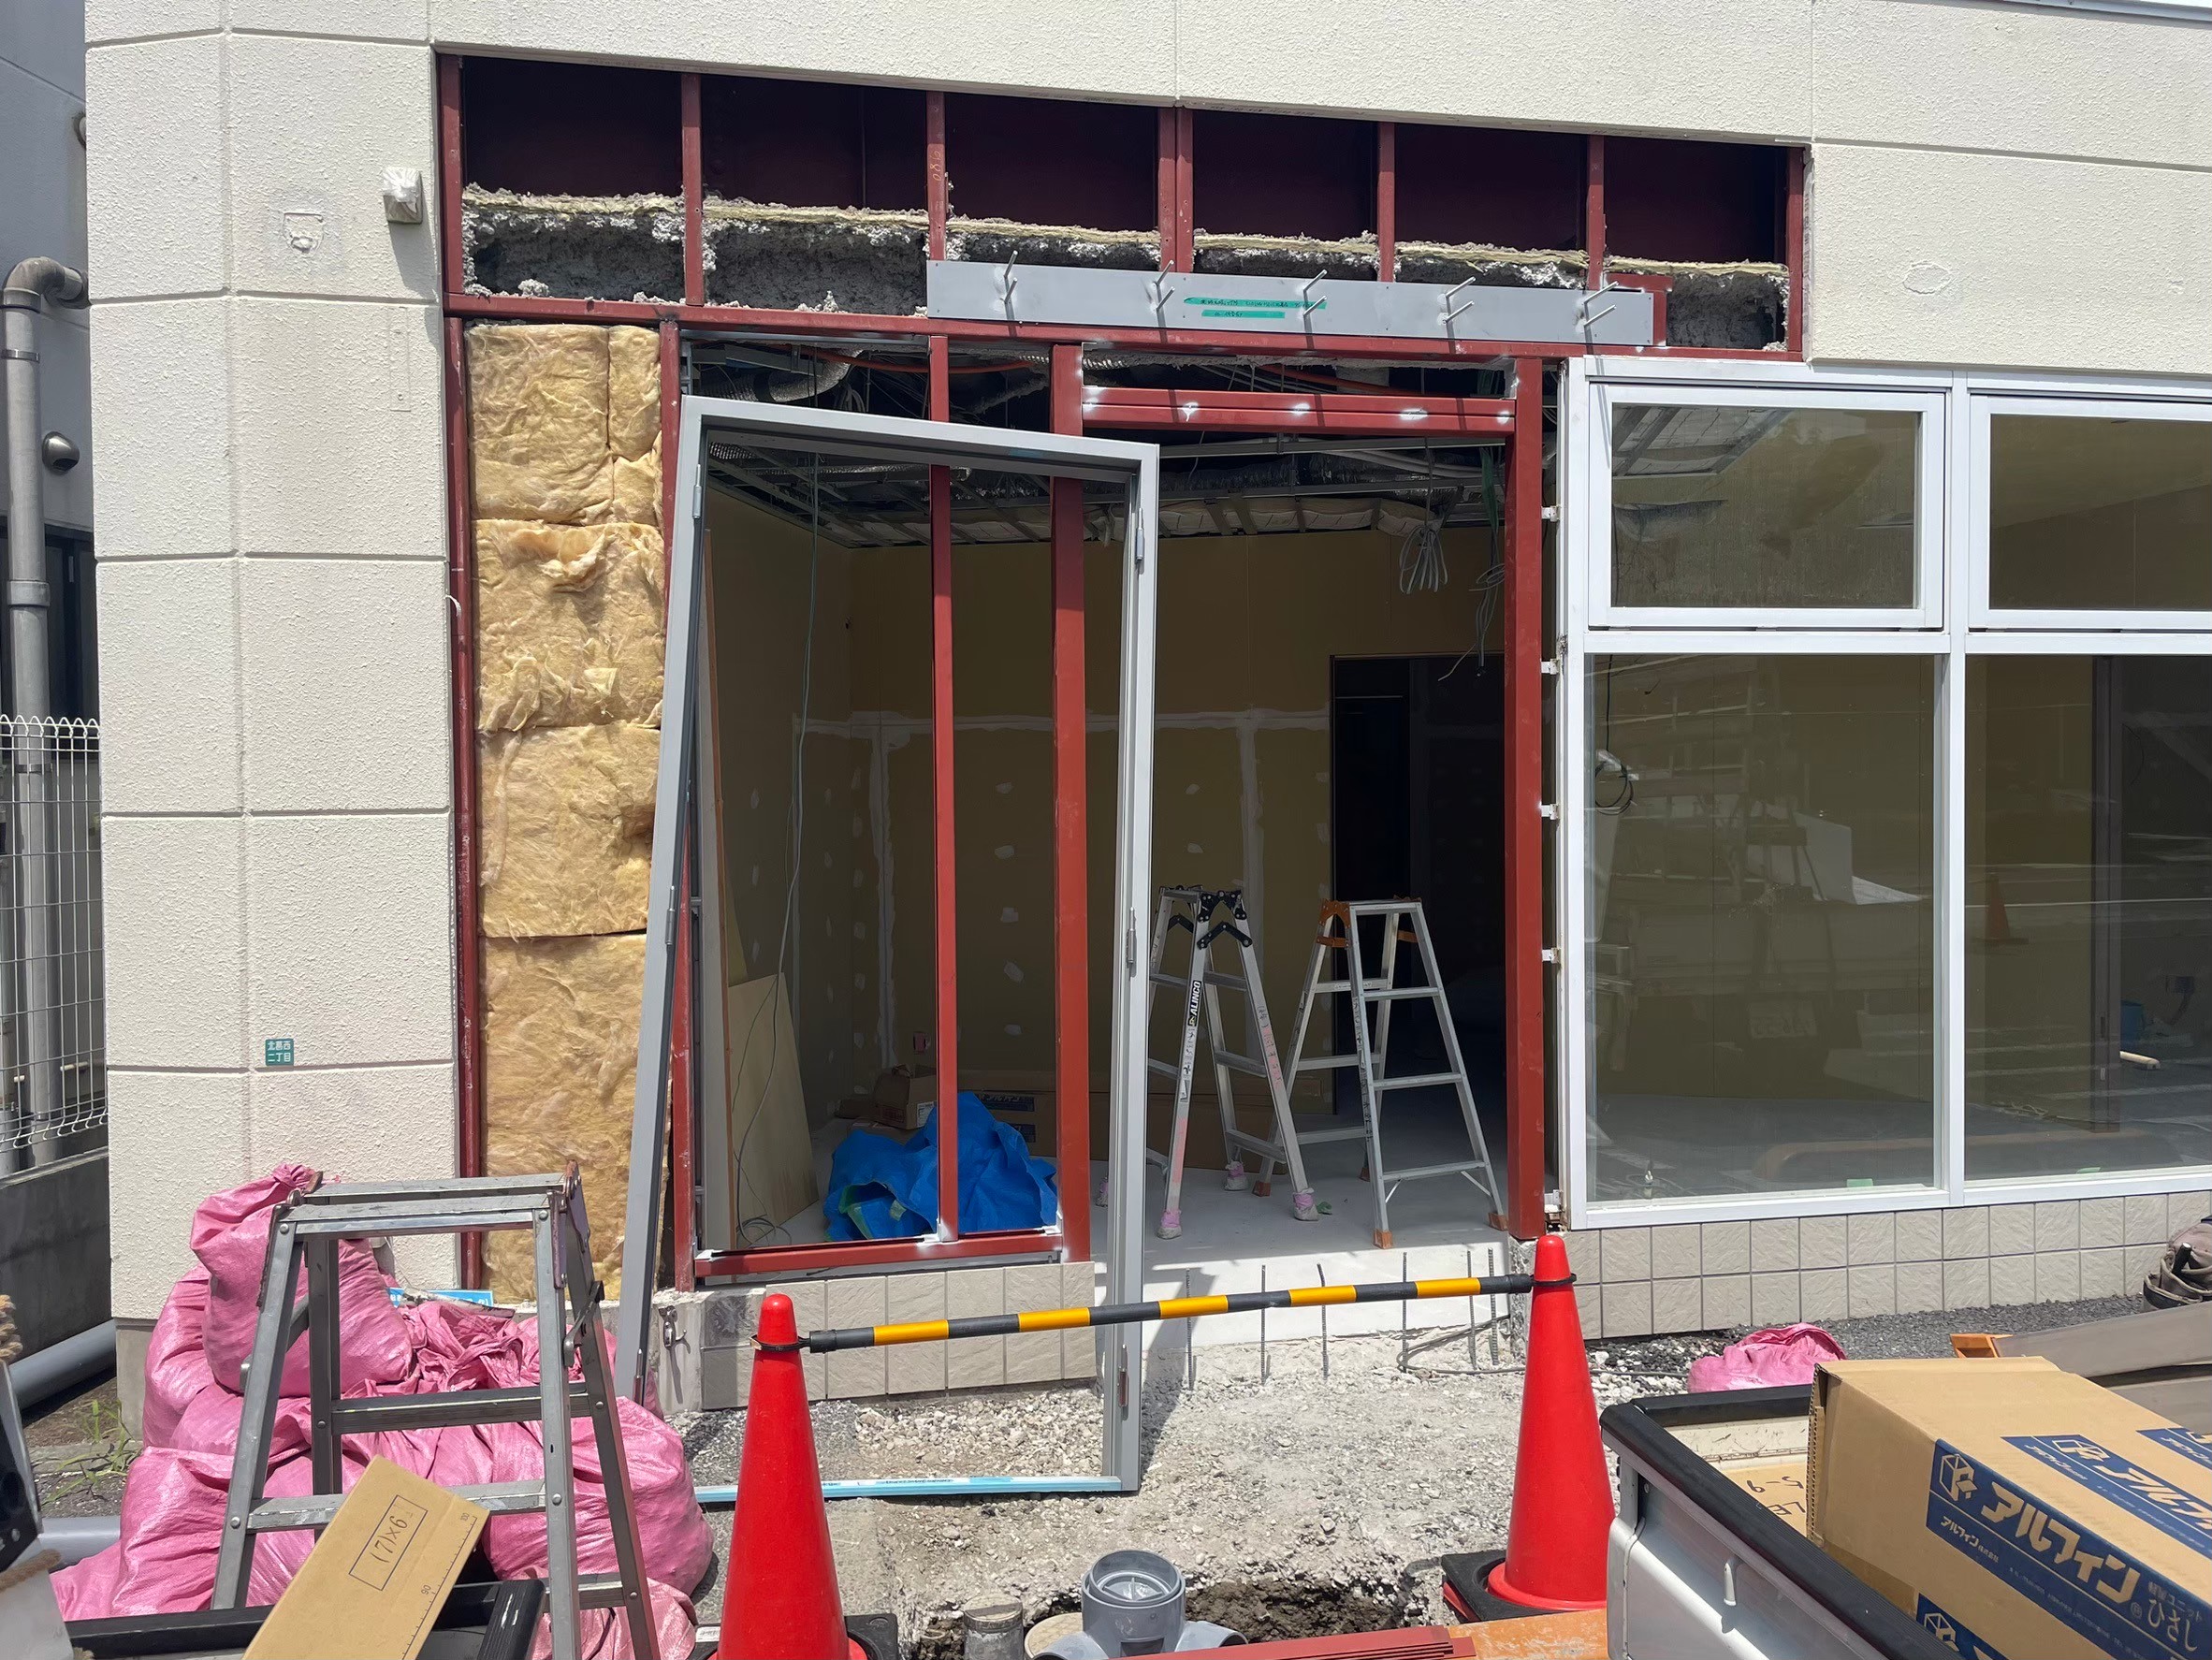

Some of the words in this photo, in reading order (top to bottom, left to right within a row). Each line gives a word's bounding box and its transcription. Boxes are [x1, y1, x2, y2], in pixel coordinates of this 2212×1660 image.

[1190, 981, 1201, 1016] ALINCO
[267, 1053, 291, 1062] 二丁目
[1980, 1481, 2141, 1604] アルフィン
[2147, 1598, 2198, 1652] ひさし
[420, 1584, 432, 1595] 90
